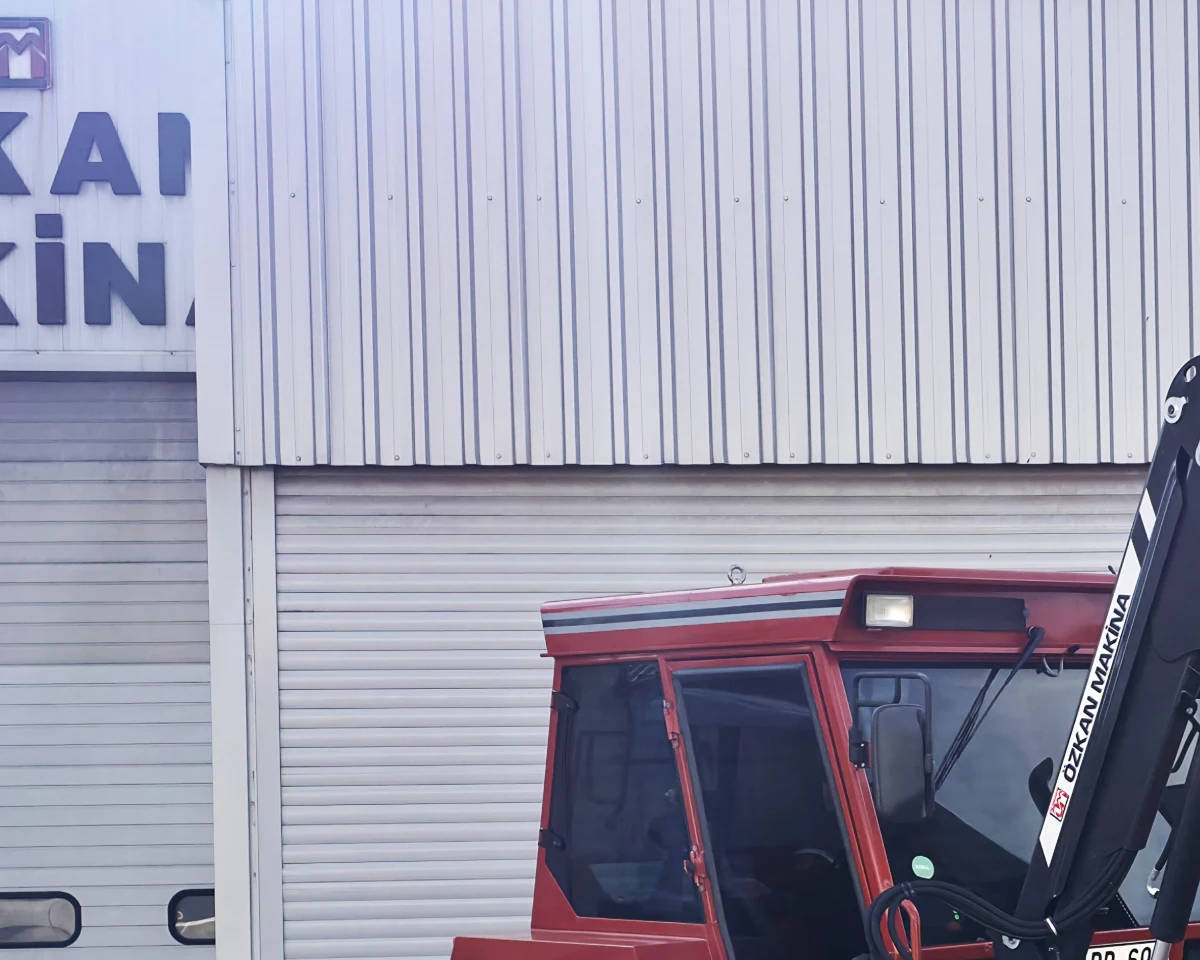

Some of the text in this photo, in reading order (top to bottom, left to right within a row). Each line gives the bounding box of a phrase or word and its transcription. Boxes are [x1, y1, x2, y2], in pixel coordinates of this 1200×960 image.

[0, 213, 195, 326] İN
[1061, 594, 1131, 783] ÖZKAN MAKİNA
